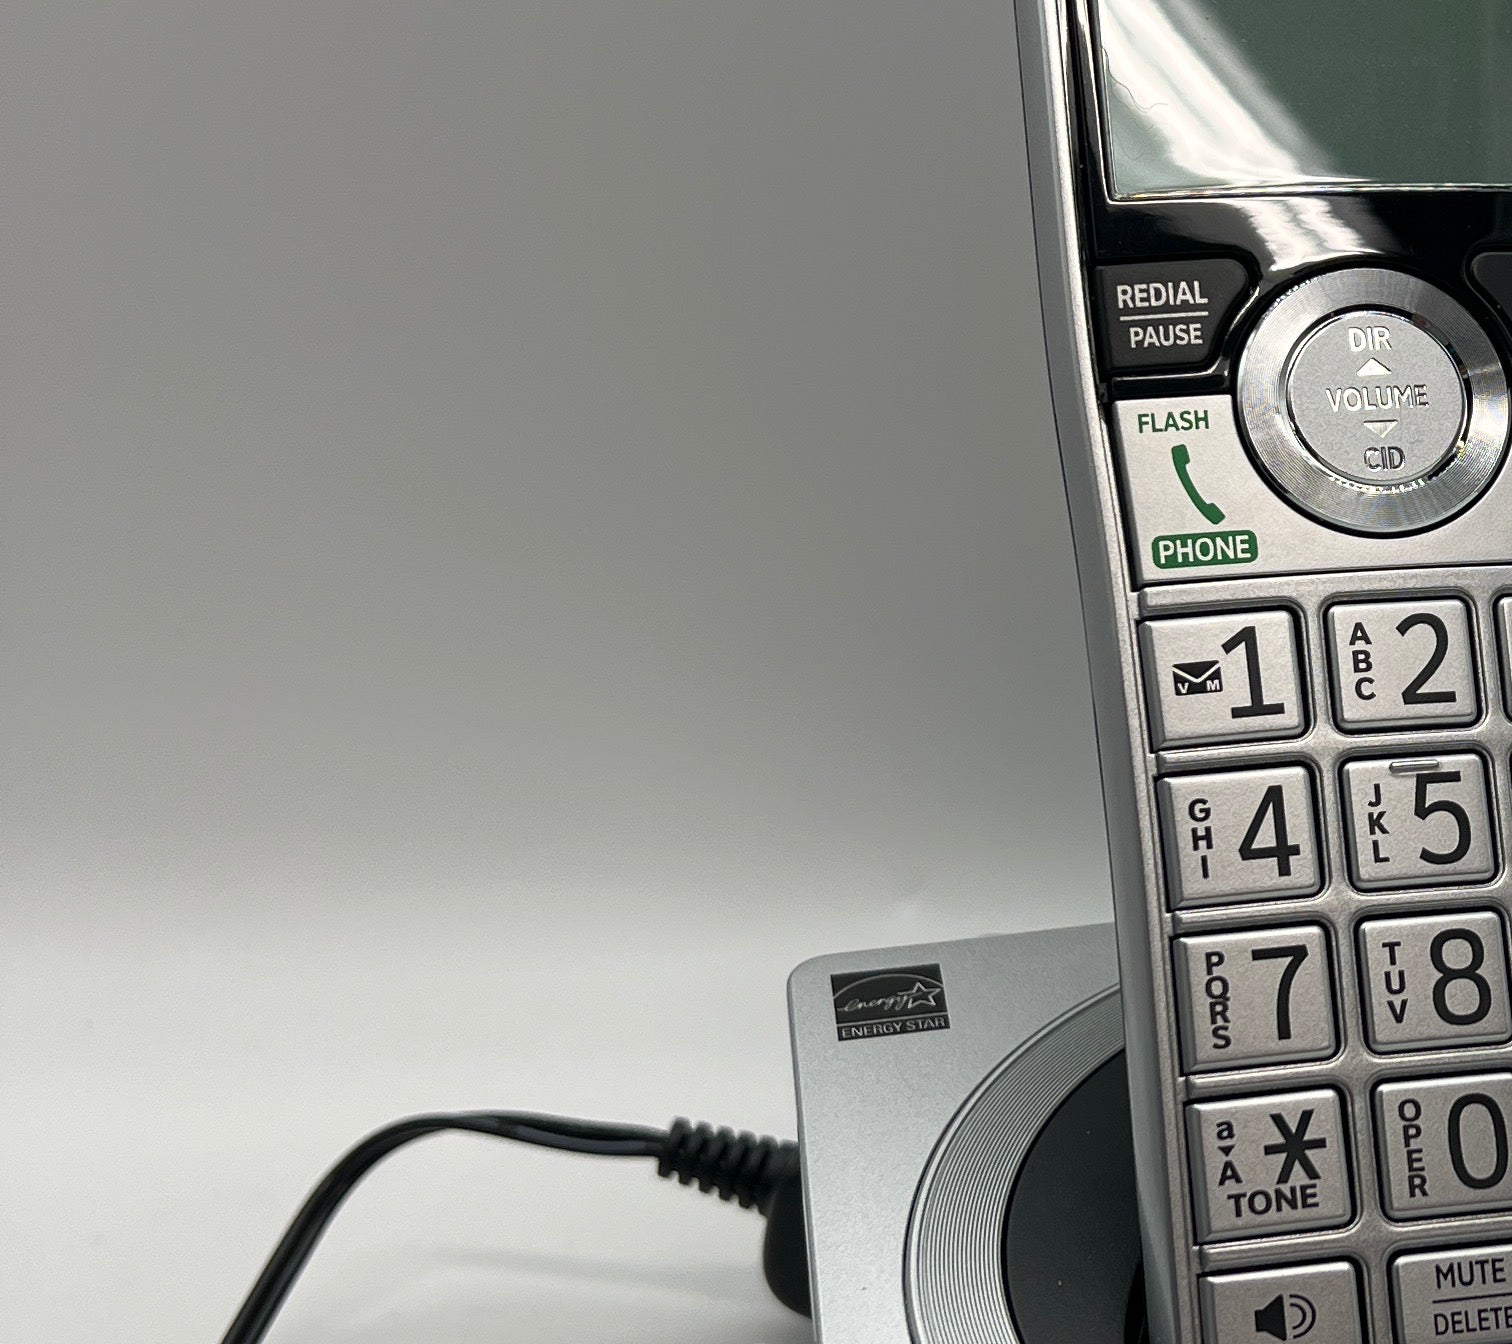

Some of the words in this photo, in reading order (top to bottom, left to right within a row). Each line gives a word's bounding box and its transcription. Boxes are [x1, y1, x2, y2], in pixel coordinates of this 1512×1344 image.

[1116, 280, 1209, 310] REDIAL
[1128, 324, 1204, 349] PAUSE
[1347, 326, 1393, 353] DIR
[1136, 410, 1210, 434] FLASH
[1324, 383, 1430, 413] VOLUME
[1363, 446, 1406, 471] CID
[1157, 536, 1252, 564] PHONE
[1221, 625, 1285, 719] 1
[1348, 621, 1377, 701] ABC
[1395, 612, 1458, 705] 2
[1187, 798, 1214, 879] GHI
[1237, 784, 1301, 878] 4
[1366, 783, 1391, 864] JKL
[1412, 770, 1472, 865] 5
[1204, 951, 1232, 1050] PQRS
[1251, 943, 1309, 1041] 7
[1381, 940, 1409, 1024] TUV
[1428, 928, 1493, 1027] 8
[841, 1021, 903, 1039] ENERGY
[905, 1016, 946, 1030] STAR
[1397, 1097, 1430, 1198] OPER
[1446, 1092, 1510, 1190] 0
[1226, 1183, 1321, 1219] TONE
[1434, 1258, 1508, 1291] MUTE
